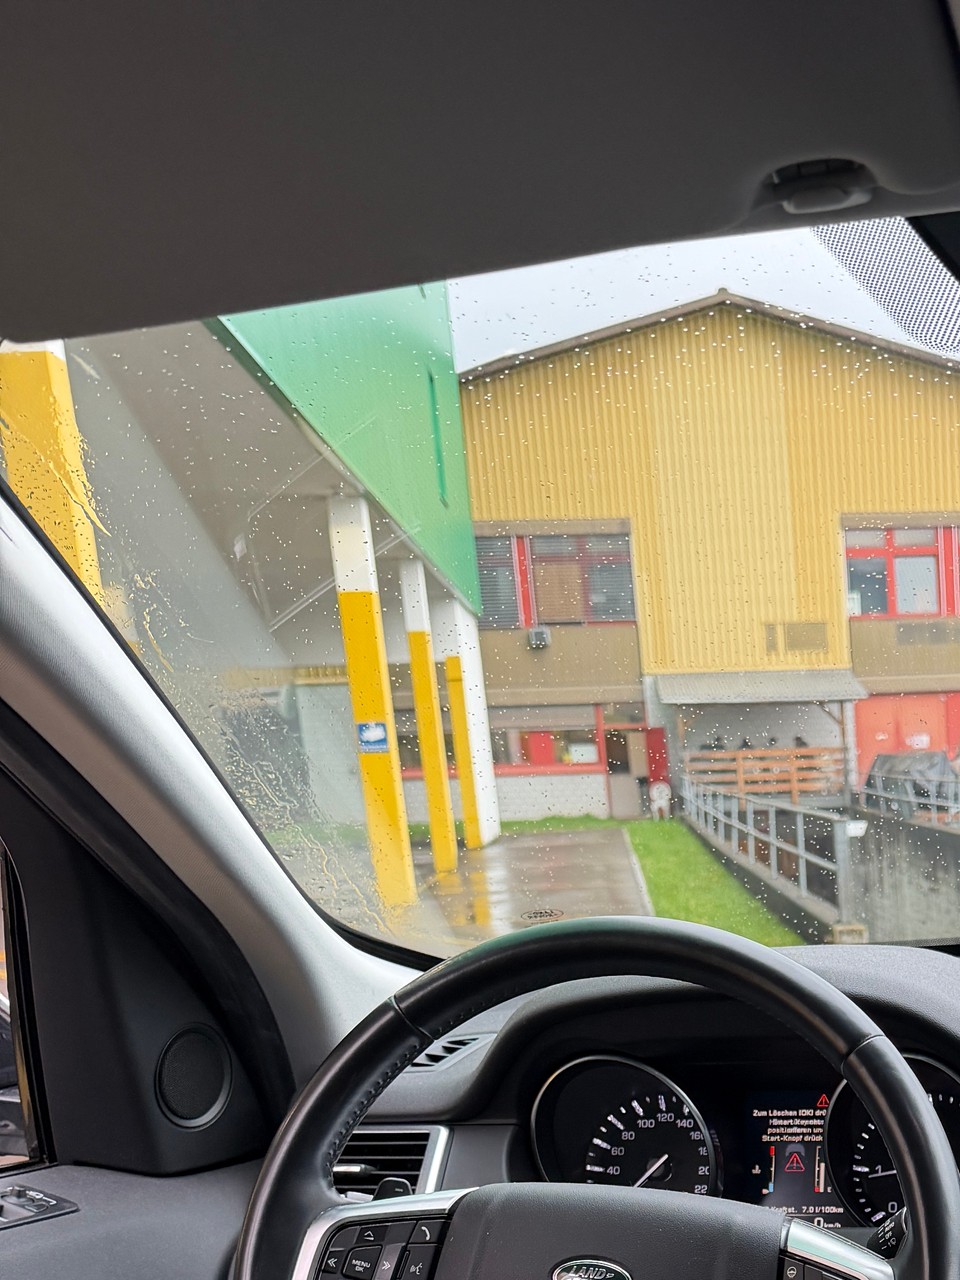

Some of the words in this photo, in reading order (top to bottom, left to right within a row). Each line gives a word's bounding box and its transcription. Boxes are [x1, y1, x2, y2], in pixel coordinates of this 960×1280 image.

[657, 1113, 674, 1122] 120
[753, 1109, 767, 1117] Zum
[637, 1119, 655, 1128] 100
[676, 1119, 693, 1128] 140
[621, 1131, 635, 1140] 80
[804, 1134, 823, 1142] drück
[611, 1147, 625, 1156] 60
[606, 1166, 620, 1175] 40
[698, 1166, 710, 1175] 20
[694, 1185, 708, 1194] 22
[888, 1201, 898, 1213] 0
[814, 1217, 824, 1229] 0
[352, 1259, 371, 1268] MENU
[569, 1265, 607, 1279] LAND
